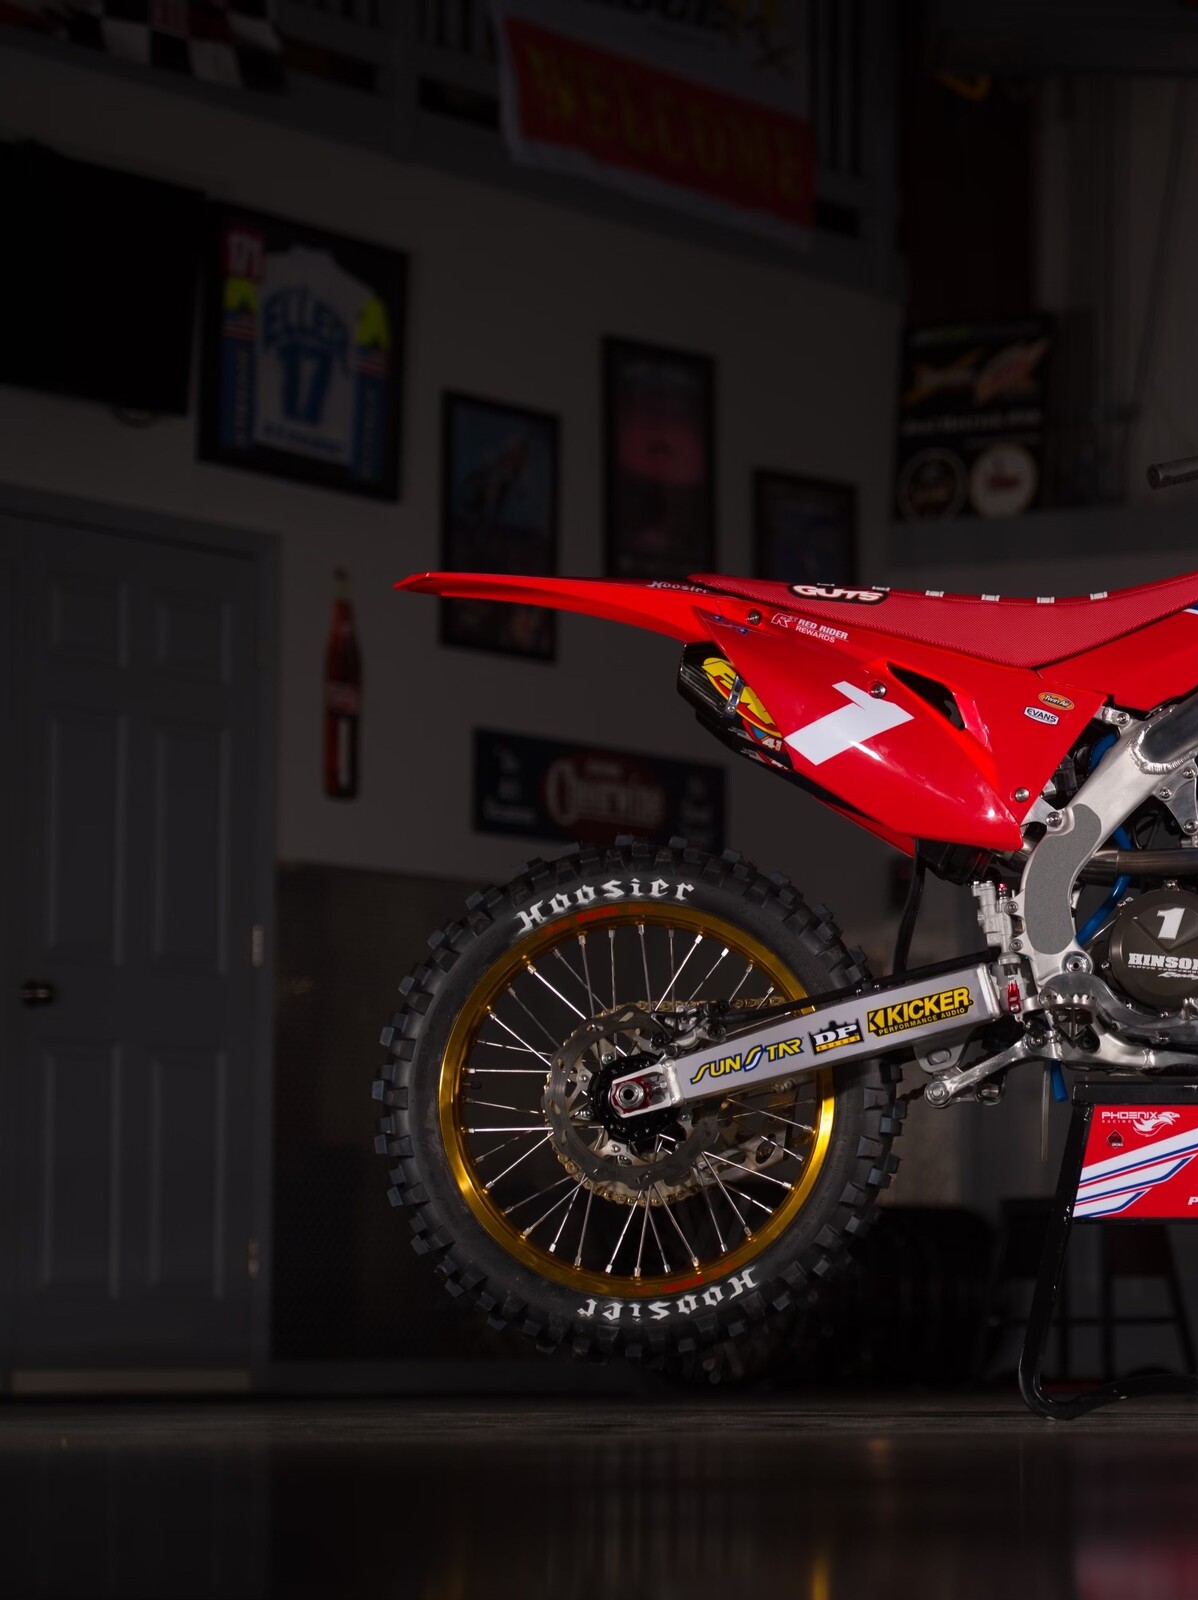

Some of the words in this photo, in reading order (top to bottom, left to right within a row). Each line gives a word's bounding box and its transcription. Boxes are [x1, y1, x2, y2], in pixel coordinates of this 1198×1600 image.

[792, 585, 884, 601] GUTS
[795, 626, 835, 643] REWARDS
[798, 618, 818, 630] RED
[819, 625, 849, 640] RIDER
[1026, 708, 1057, 724] EVANS
[514, 878, 695, 935] Hoosier
[1156, 907, 1186, 940] 1
[884, 987, 972, 1028] KICKER
[878, 1014, 938, 1036] PERFORMANCE
[940, 1007, 966, 1020] AUDIO
[813, 1024, 859, 1046] DP
[1101, 1111, 1159, 1120] PHOENIX
[576, 1265, 759, 1322] Hoosier
